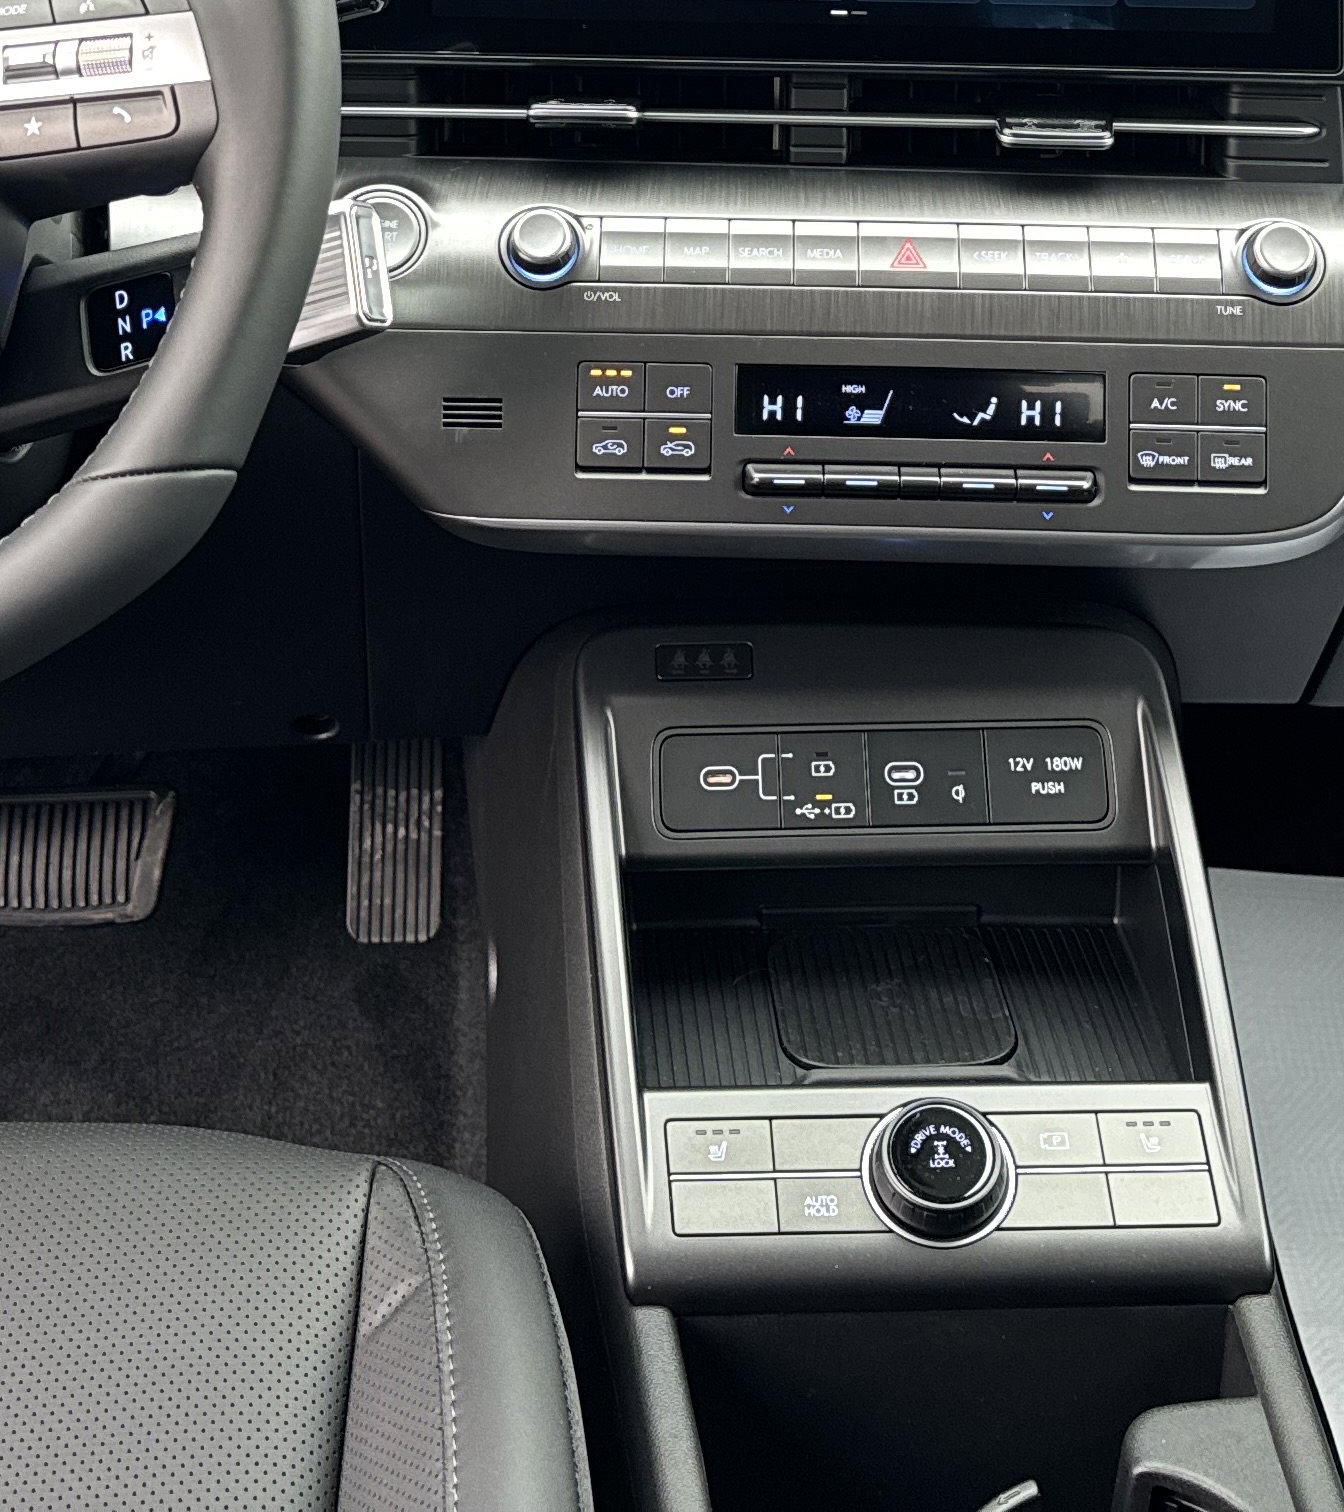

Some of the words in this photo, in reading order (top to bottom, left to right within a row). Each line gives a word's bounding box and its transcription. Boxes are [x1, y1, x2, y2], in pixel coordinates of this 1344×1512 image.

[684, 245, 709, 256] MAP
[738, 247, 783, 258] SEARCH
[807, 248, 842, 260] MEDIA
[115, 291, 128, 309] D
[1216, 306, 1242, 315] TUNE
[141, 309, 153, 330] P
[118, 316, 130, 335] N
[121, 342, 133, 361] R
[593, 386, 628, 397] AUTO
[667, 387, 690, 398] OFF
[842, 385, 865, 393] HIGH
[1151, 398, 1177, 409] A/C
[1216, 400, 1247, 411] SYNC
[1159, 454, 1189, 466] FRONT
[1229, 455, 1253, 466] REAR
[1009, 758, 1033, 771] 12V
[1046, 757, 1082, 771] 180W
[1031, 782, 1064, 794] PUSH
[910, 1125, 937, 1149] DRIVE
[939, 1125, 969, 1147] MODE
[929, 1159, 956, 1168] LOCK
[804, 1195, 838, 1206] AUTO
[804, 1205, 839, 1217] HOLD
